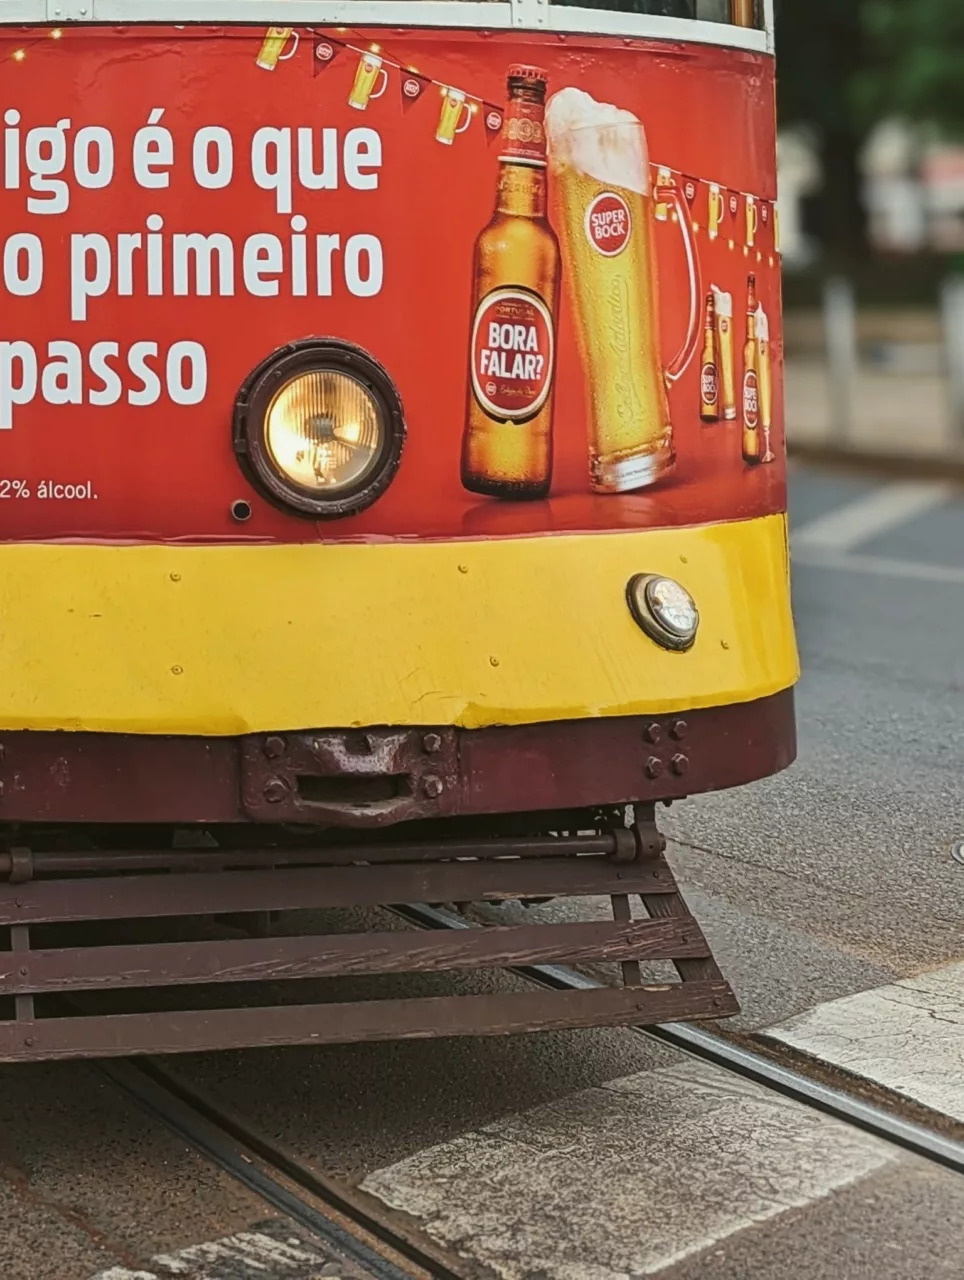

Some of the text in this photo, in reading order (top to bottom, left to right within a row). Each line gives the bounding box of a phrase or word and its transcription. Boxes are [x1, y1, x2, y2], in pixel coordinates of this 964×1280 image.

[132, 107, 174, 190] é
[192, 126, 234, 189] o
[251, 126, 382, 214] que
[591, 208, 626, 227] SUPER
[595, 222, 626, 239] BOCK
[3, 232, 44, 296] o
[70, 213, 384, 321] primeiro
[488, 321, 539, 352] BORA
[479, 348, 544, 380] FALAR?
[37, 478, 98, 500] álcool.
